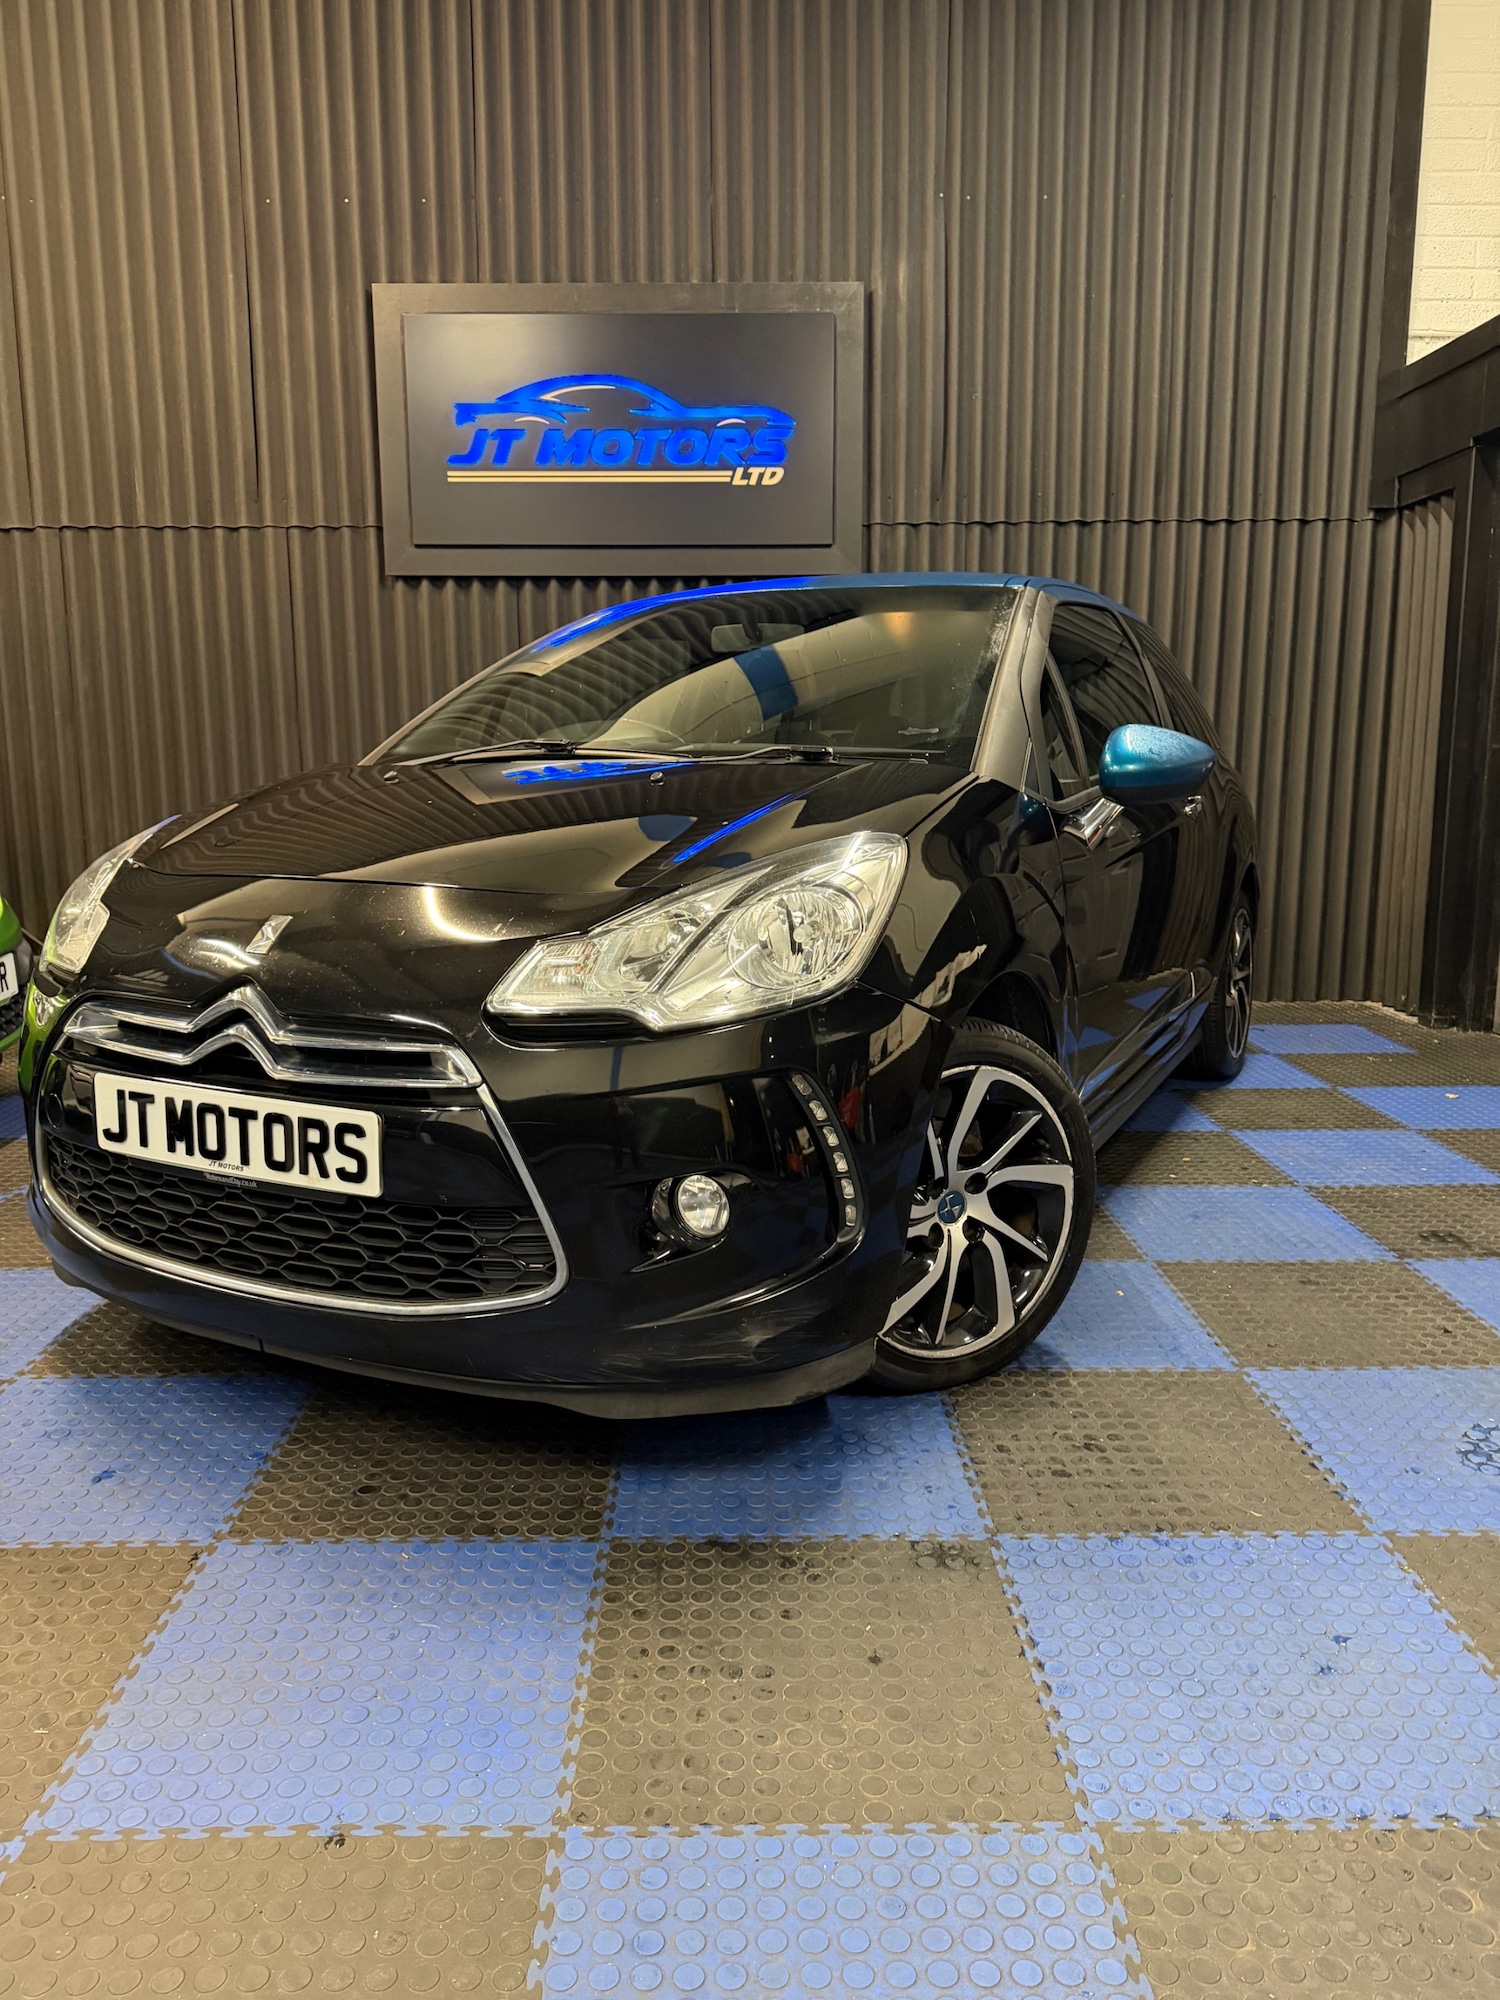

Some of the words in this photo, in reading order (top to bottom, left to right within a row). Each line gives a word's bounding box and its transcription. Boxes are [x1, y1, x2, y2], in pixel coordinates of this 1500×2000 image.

[447, 428, 527, 466] JT
[535, 428, 796, 466] MOTORS
[731, 467, 786, 486] LTD
[102, 1089, 155, 1148] JT
[164, 1096, 368, 1184] MOTORS
[217, 1162, 244, 1172] MOTORS
